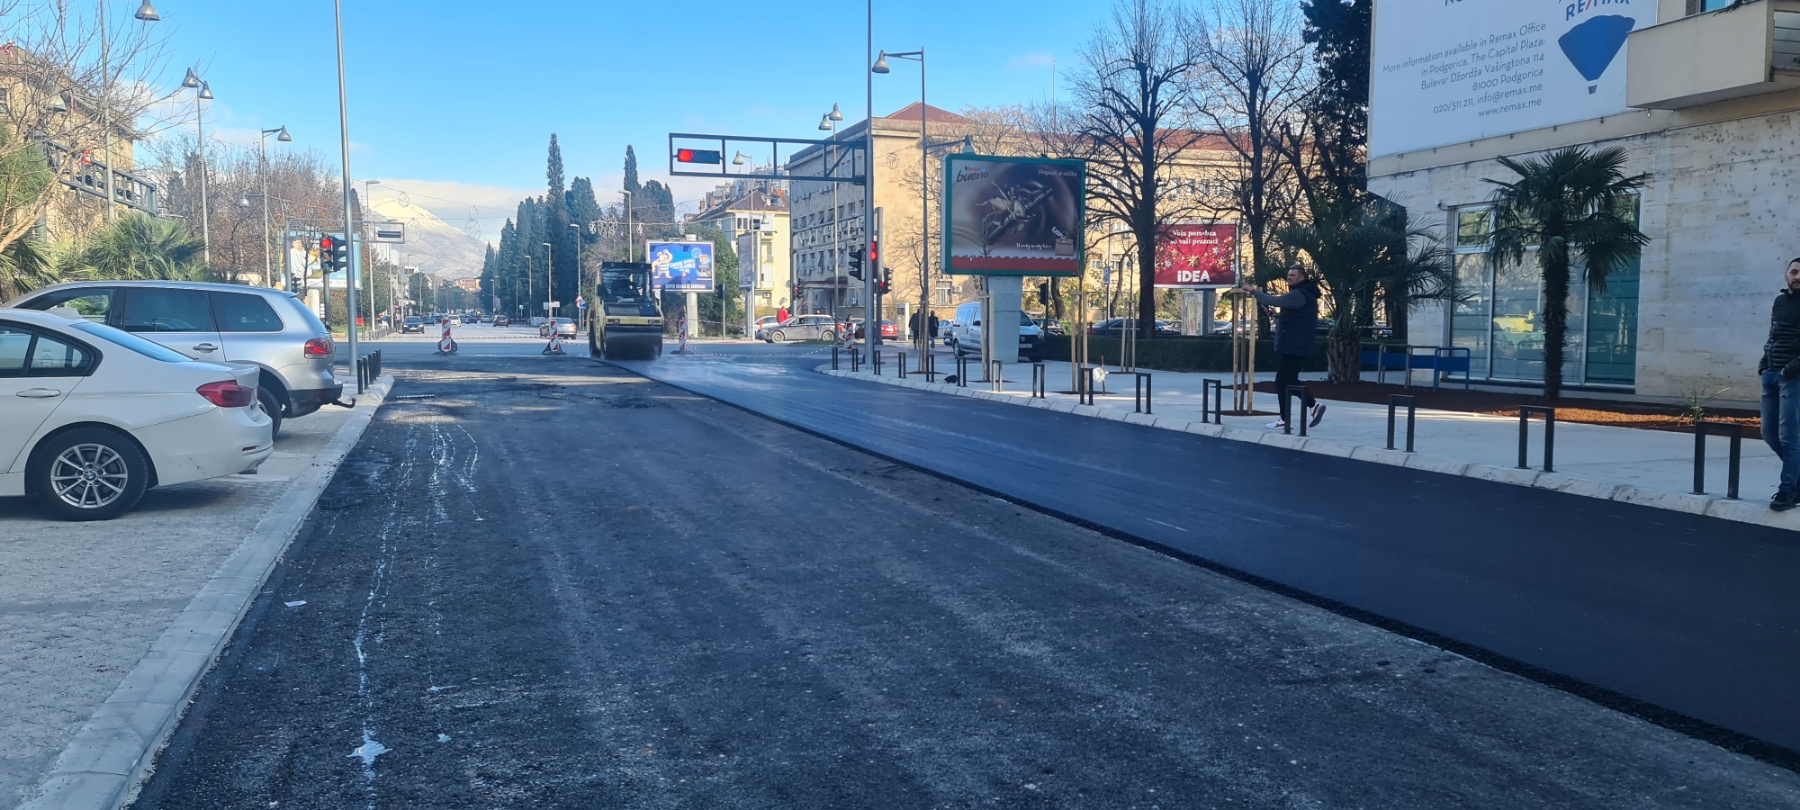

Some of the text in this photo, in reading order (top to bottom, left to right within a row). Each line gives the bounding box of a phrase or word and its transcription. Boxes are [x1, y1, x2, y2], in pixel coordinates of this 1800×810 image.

[1382, 22, 1546, 73] More information available in Remax Office
[1421, 38, 1546, 76] in Podgorica, The Capital Plaza:
[1421, 53, 1545, 90] Bulevar Džordža Vašingtona 114
[1472, 67, 1544, 91] 81000 Podgorica
[1433, 83, 1543, 114] 020/511 211, info@remax.me
[1478, 98, 1542, 117] www.remax.me
[956, 170, 988, 182] bueno
[1177, 270, 1211, 282] IDEA
